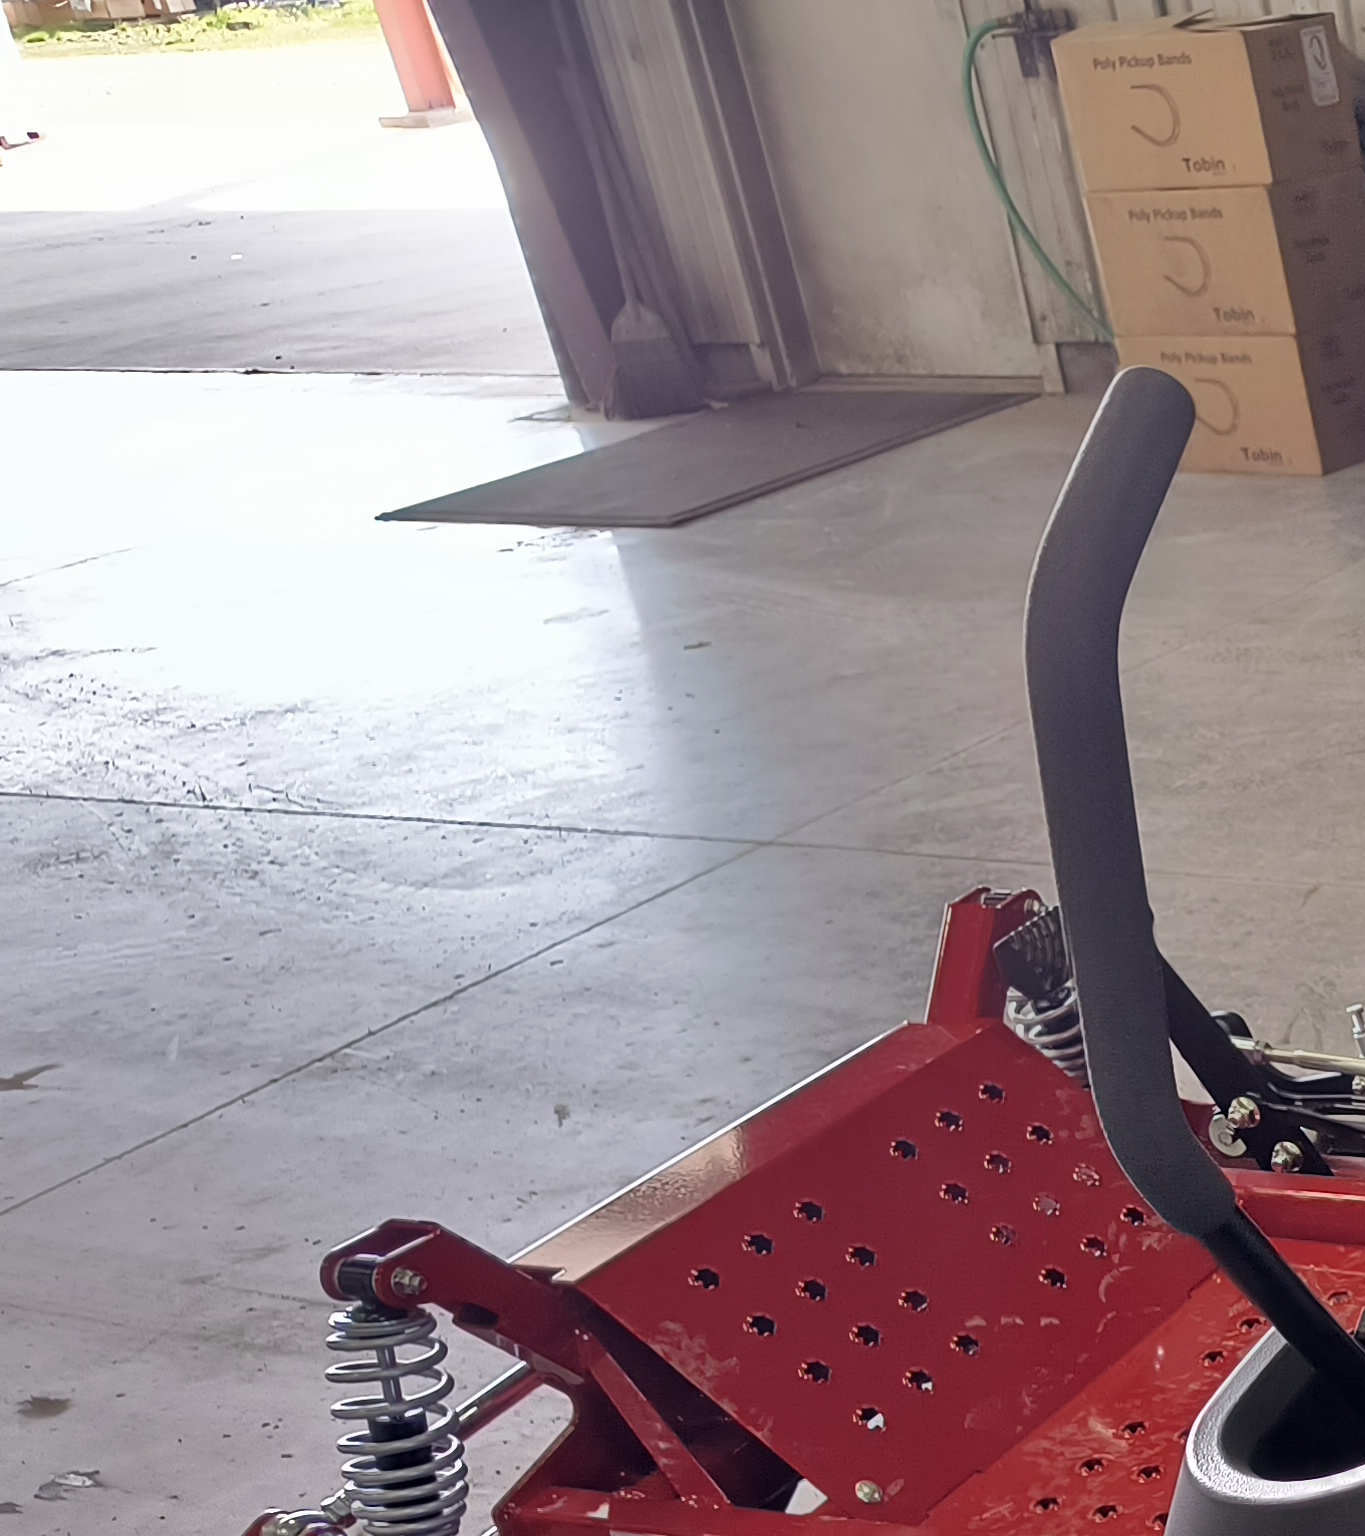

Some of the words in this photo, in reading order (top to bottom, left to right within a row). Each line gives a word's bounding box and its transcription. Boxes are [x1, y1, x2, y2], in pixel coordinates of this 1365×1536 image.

[1093, 56, 1117, 71] Poly
[1119, 54, 1156, 70] Pickup
[1157, 52, 1192, 66] Bands
[1182, 157, 1226, 173] Tobin
[1128, 209, 1150, 223] Poly
[1213, 307, 1255, 322] Tobin
